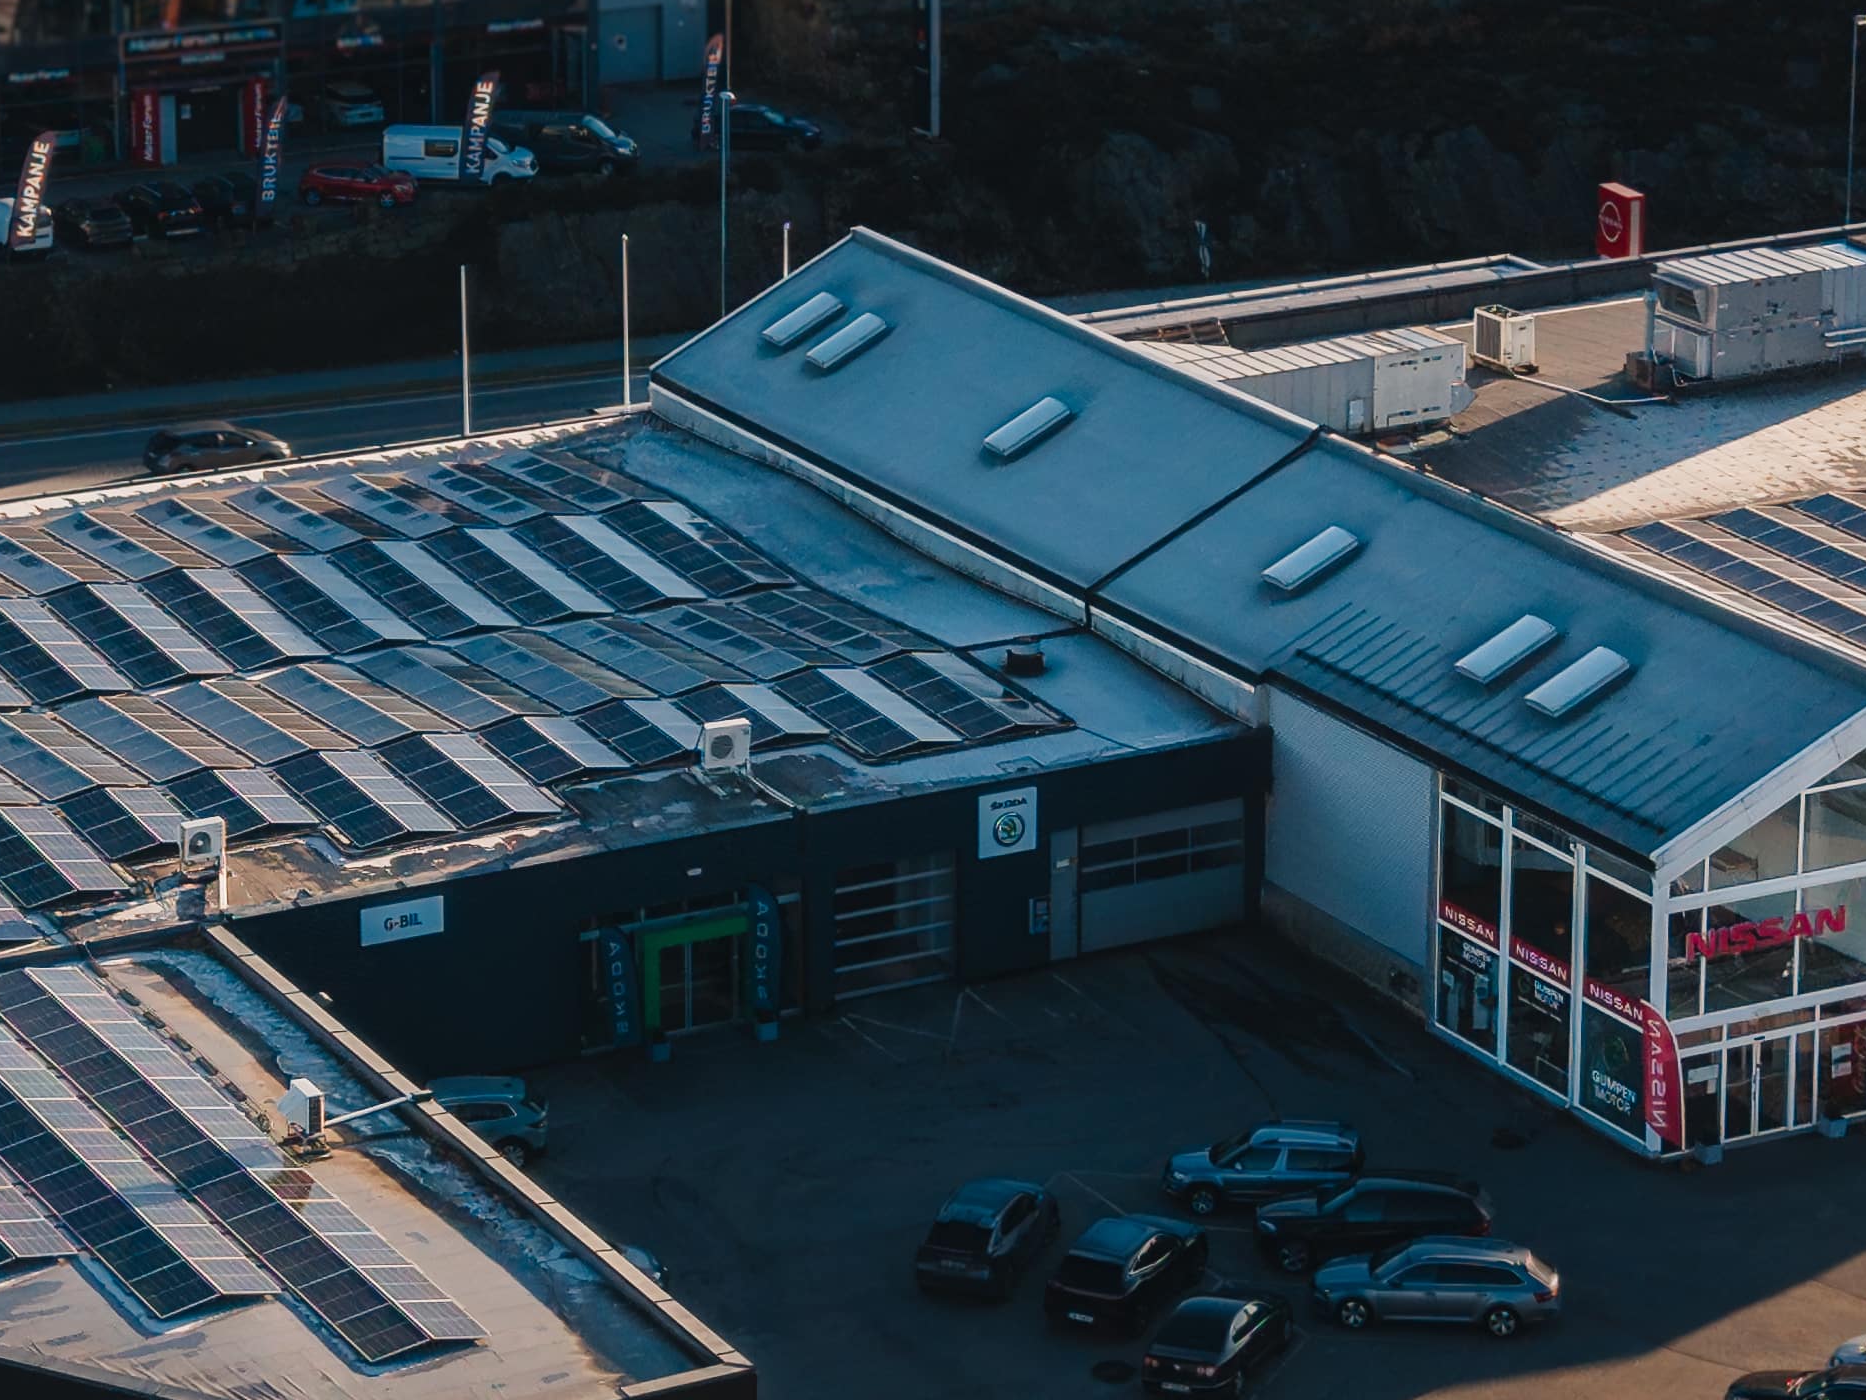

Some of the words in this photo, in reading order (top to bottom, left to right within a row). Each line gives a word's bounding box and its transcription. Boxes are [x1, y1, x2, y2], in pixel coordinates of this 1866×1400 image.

[465, 80, 494, 175] KAMPANJE
[16, 140, 51, 239] KAMPANJE
[1444, 903, 1495, 943] NISSAN
[1685, 904, 1847, 963] NISSAN
[1515, 943, 1568, 983] NISSAN
[1588, 983, 1644, 1022] NISSAN
[1591, 1069, 1638, 1104] GUMPEN
[1593, 1085, 1632, 1116] MOTOR
